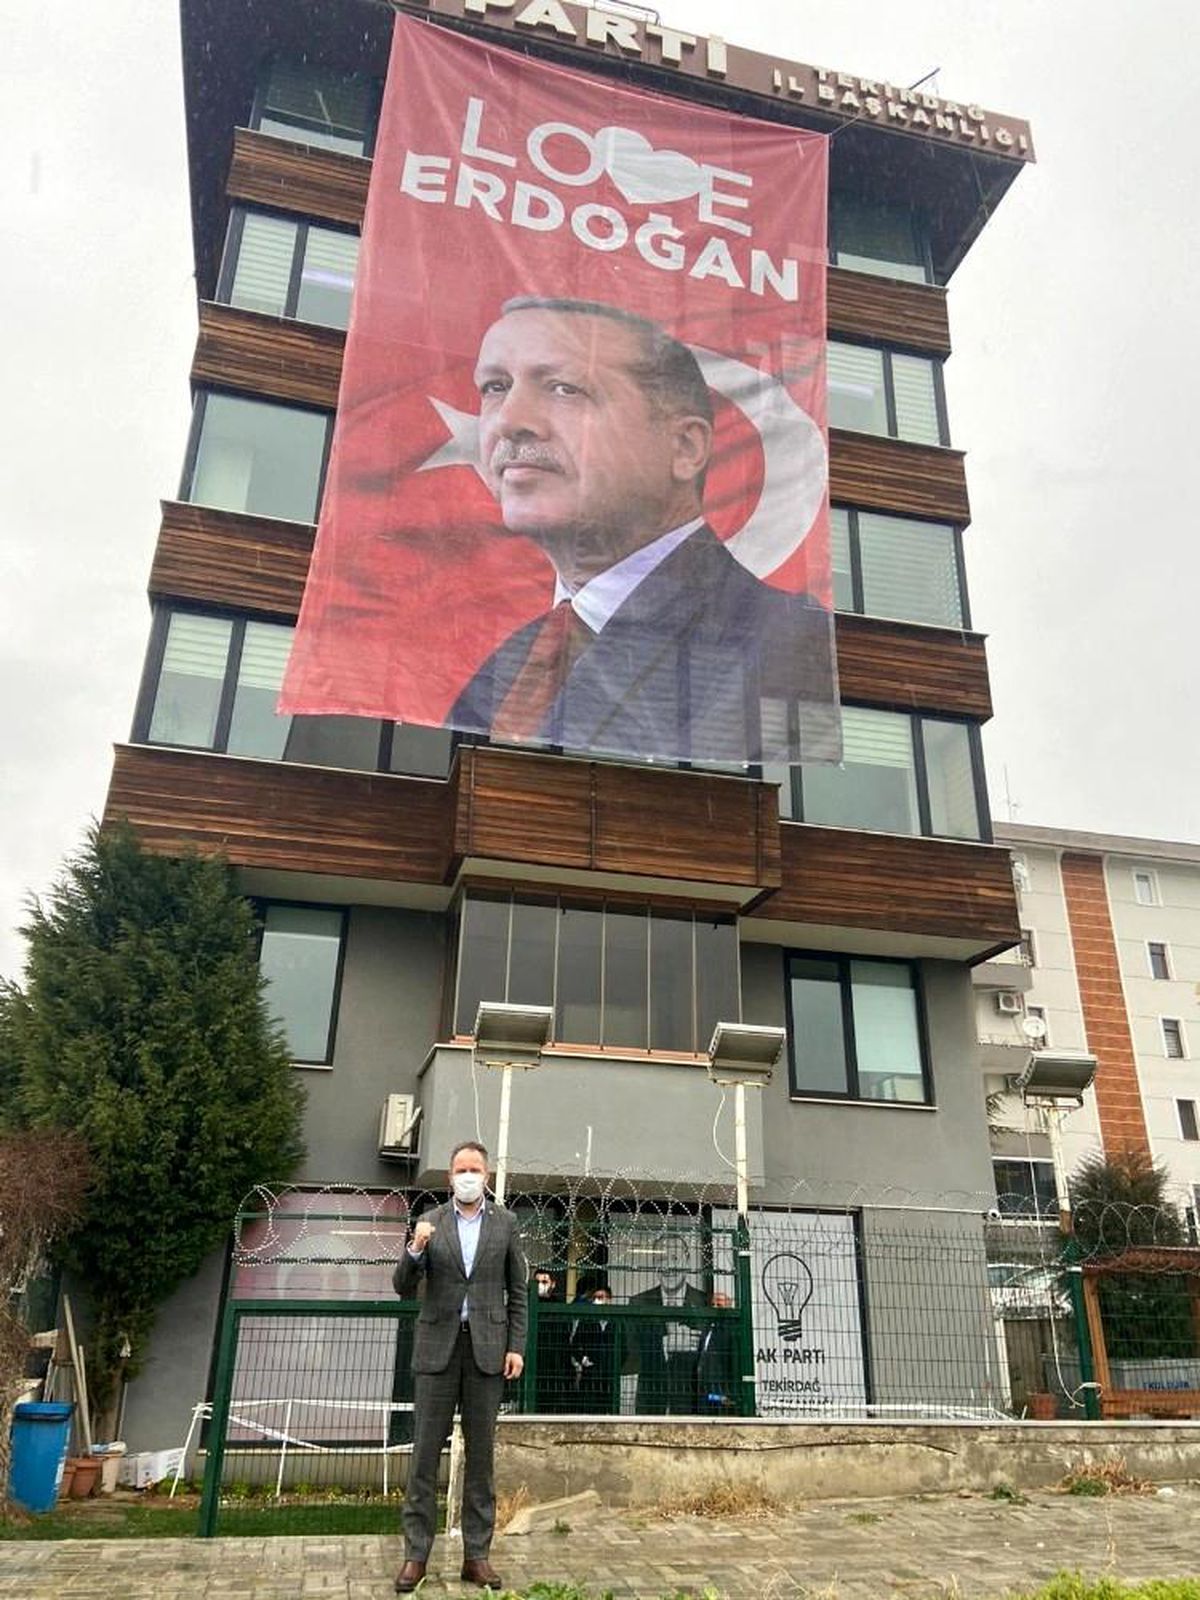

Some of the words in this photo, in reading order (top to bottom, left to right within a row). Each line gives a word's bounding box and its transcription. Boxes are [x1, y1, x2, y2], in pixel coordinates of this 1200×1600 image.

[400, 149, 799, 301] ERDOĞAN
[757, 1348, 777, 1364] AK
[761, 1376, 821, 1393] TEKİRDAĞ
